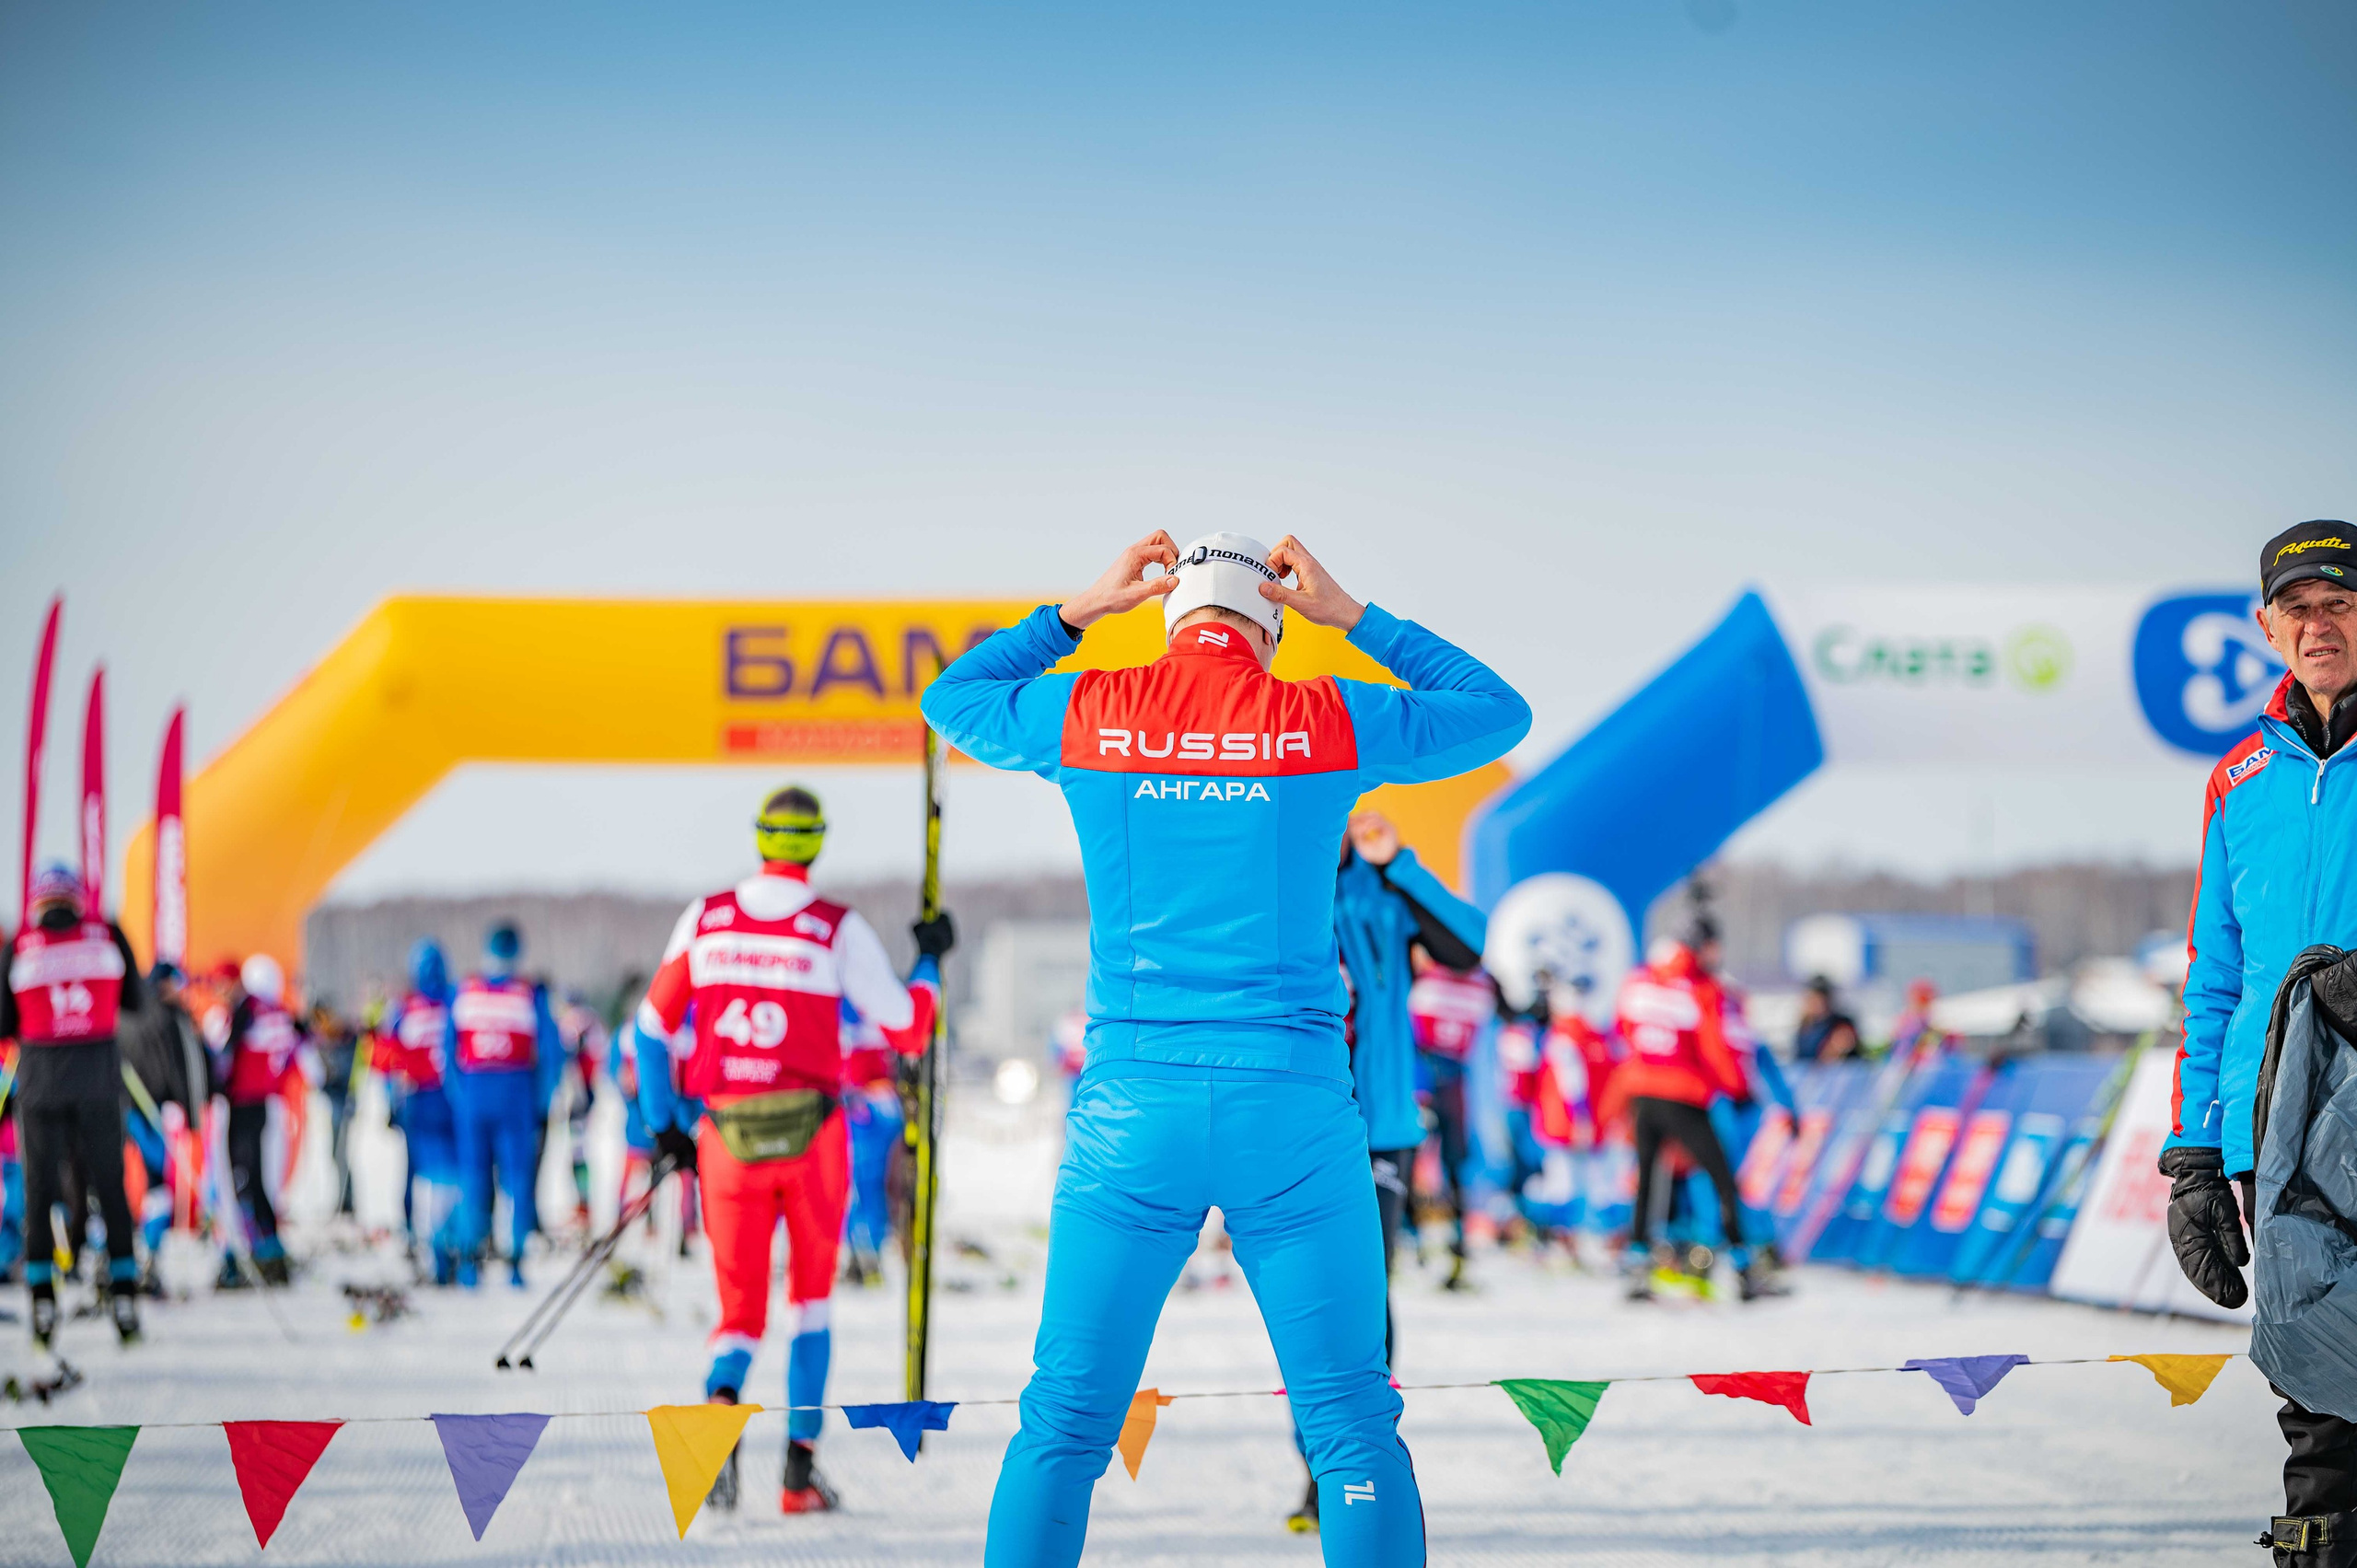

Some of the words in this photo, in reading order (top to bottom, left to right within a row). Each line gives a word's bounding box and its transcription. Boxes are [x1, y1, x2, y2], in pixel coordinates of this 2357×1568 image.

[1209, 549, 1276, 581] noname
[2272, 537, 2351, 567] Aquatic
[1098, 728, 1311, 761] RUSSIA
[1133, 780, 1271, 802] АНГАРА
[714, 997, 788, 1049] 49
